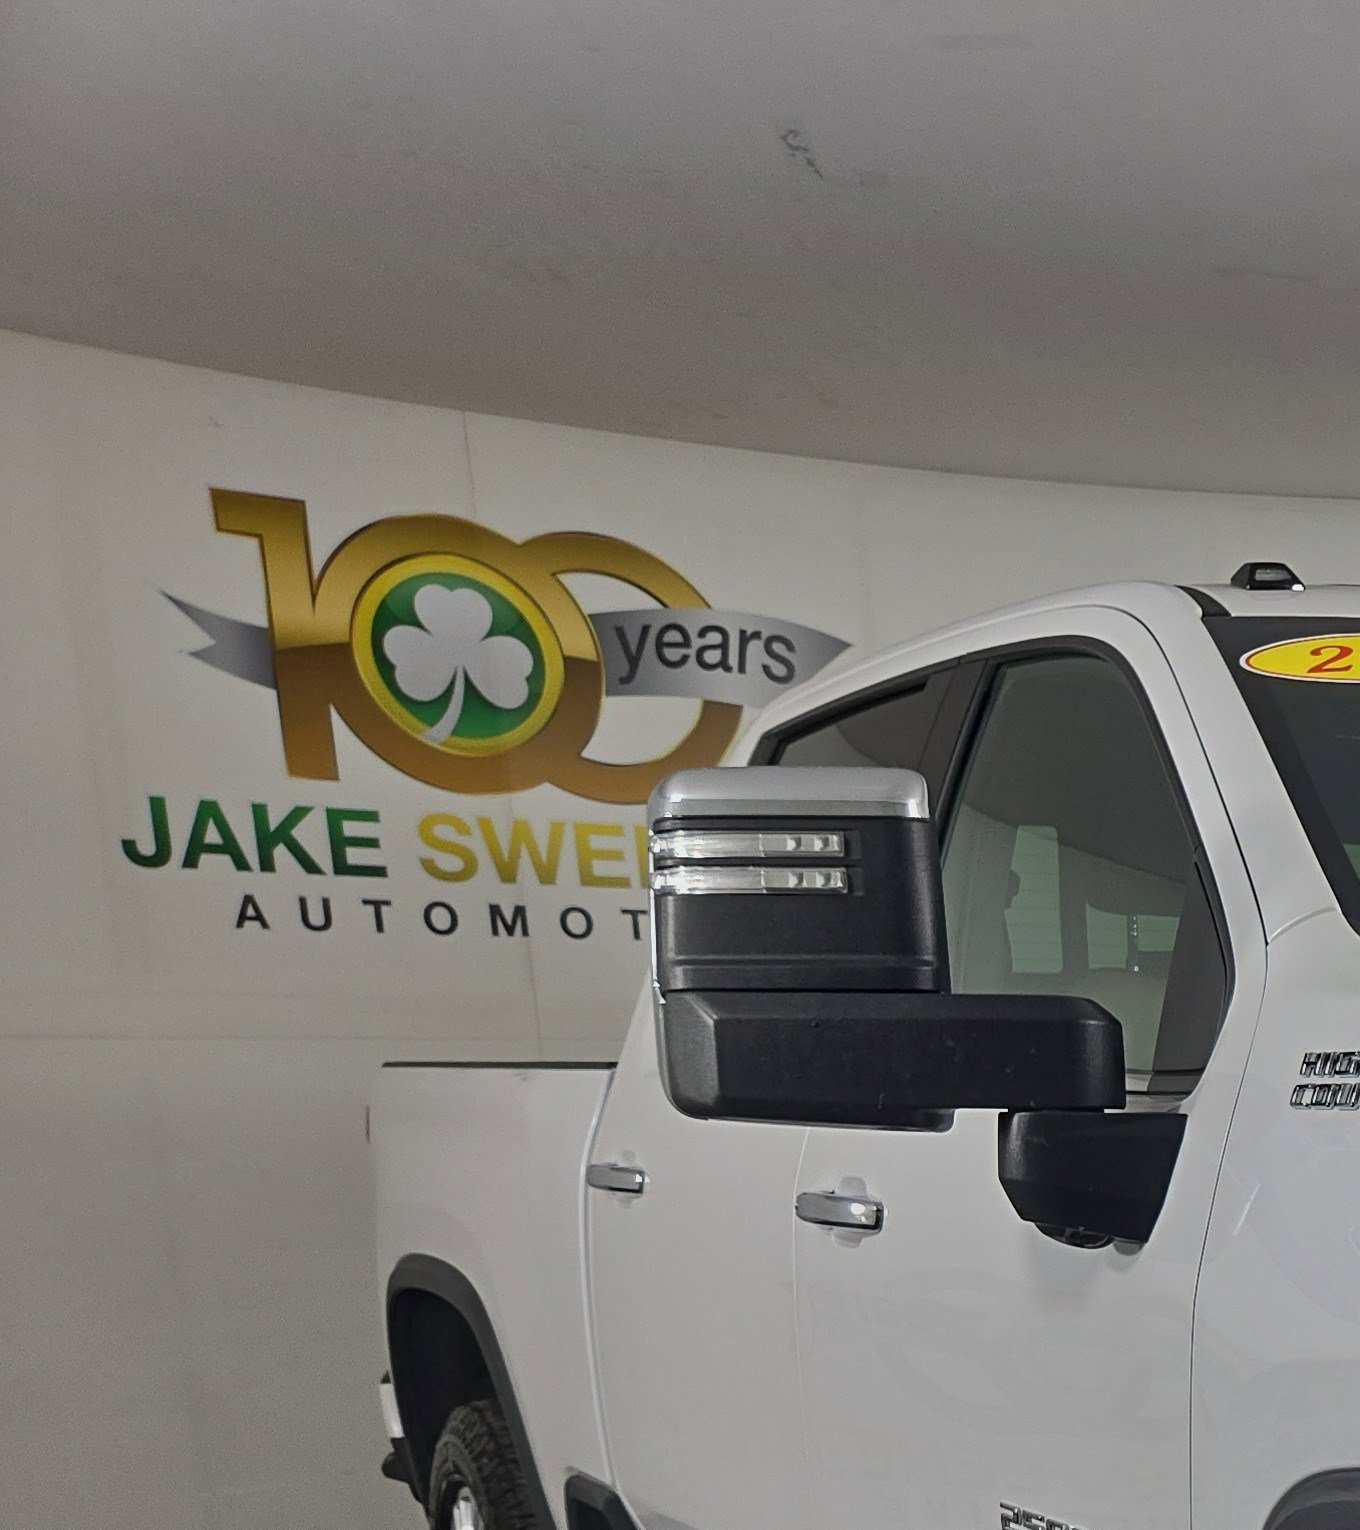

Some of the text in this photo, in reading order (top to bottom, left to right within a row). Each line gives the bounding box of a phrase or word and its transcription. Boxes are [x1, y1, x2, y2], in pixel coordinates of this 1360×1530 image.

[613, 619, 797, 685] years
[121, 796, 389, 879] JAKE
[235, 894, 648, 941] AUTOMOT
